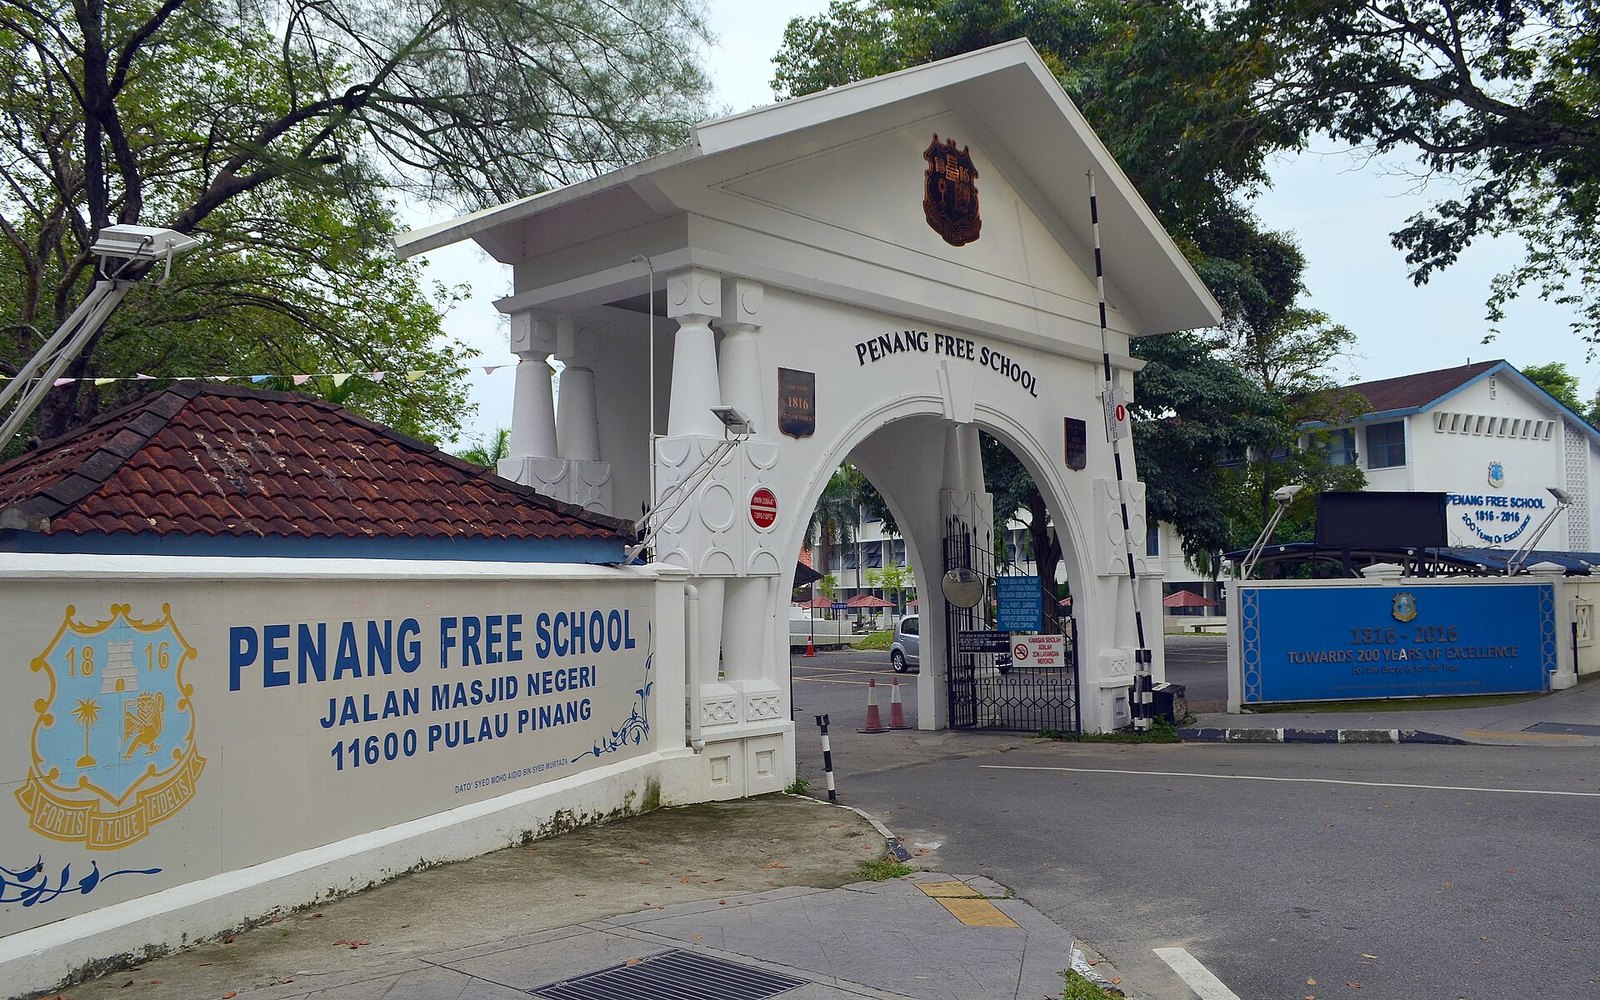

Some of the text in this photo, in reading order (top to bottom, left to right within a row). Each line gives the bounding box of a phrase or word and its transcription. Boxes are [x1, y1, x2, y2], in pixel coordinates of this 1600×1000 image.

[855, 330, 1038, 398] PENANG FREE SCHOOL
[788, 396, 809, 410] 1816
[1447, 494, 1545, 509] PENANG FREE SCHOOL
[1475, 510, 1494, 521] 1816
[1501, 511, 1520, 522] 2016
[1462, 513, 1476, 531] 200
[229, 609, 636, 692] PENANG FREE SCHOOL
[1351, 627, 1396, 645] 1816
[1414, 625, 1459, 643] 2016
[64, 645, 95, 678] 18
[143, 641, 170, 672] 16
[1288, 646, 1519, 664] TOWARDS 200 YEARS OF EXCELLENCE
[319, 665, 596, 729] JALAN MASJID NEGERI
[331, 698, 592, 771] 11600 PULAU PINANG
[474, 778, 490, 789] SYED
[491, 773, 507, 784] MOHD
[523, 766, 532, 776] BIN
[532, 763, 545, 773] SYED
[545, 758, 568, 770] MURTAZA
[150, 778, 190, 819] FIDELIS
[36, 802, 84, 835] FORTIS
[96, 814, 140, 843] ATQUE
